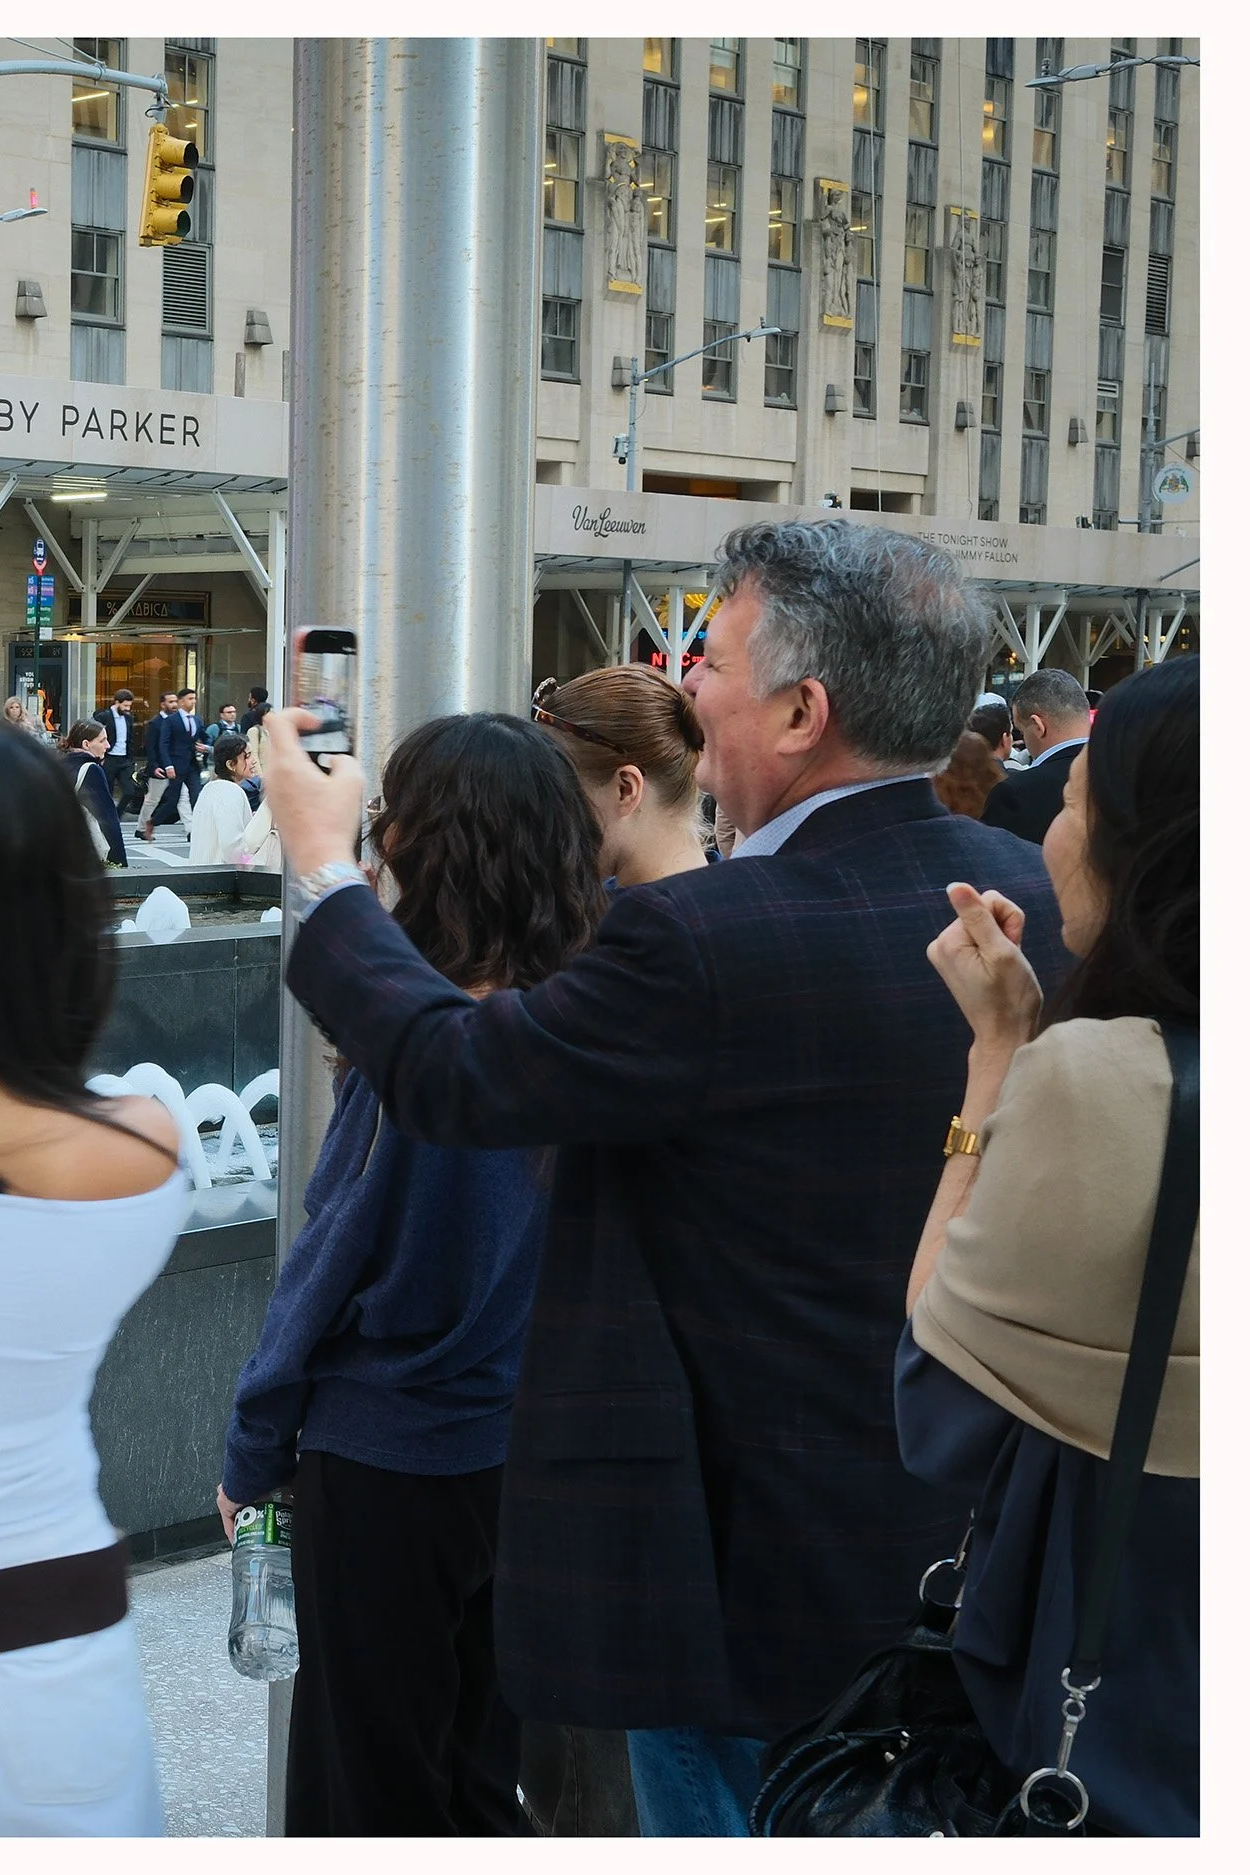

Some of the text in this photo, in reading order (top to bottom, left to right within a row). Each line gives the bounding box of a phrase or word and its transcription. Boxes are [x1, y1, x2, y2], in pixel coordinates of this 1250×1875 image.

[62, 405, 201, 447] PARKER
[918, 532, 1008, 548] THE TONIGHT SHOW
[955, 549, 983, 560] JIMMY
[985, 551, 1018, 563] FALLON
[127, 602, 168, 617] ABICA
[652, 652, 690, 667] NC
